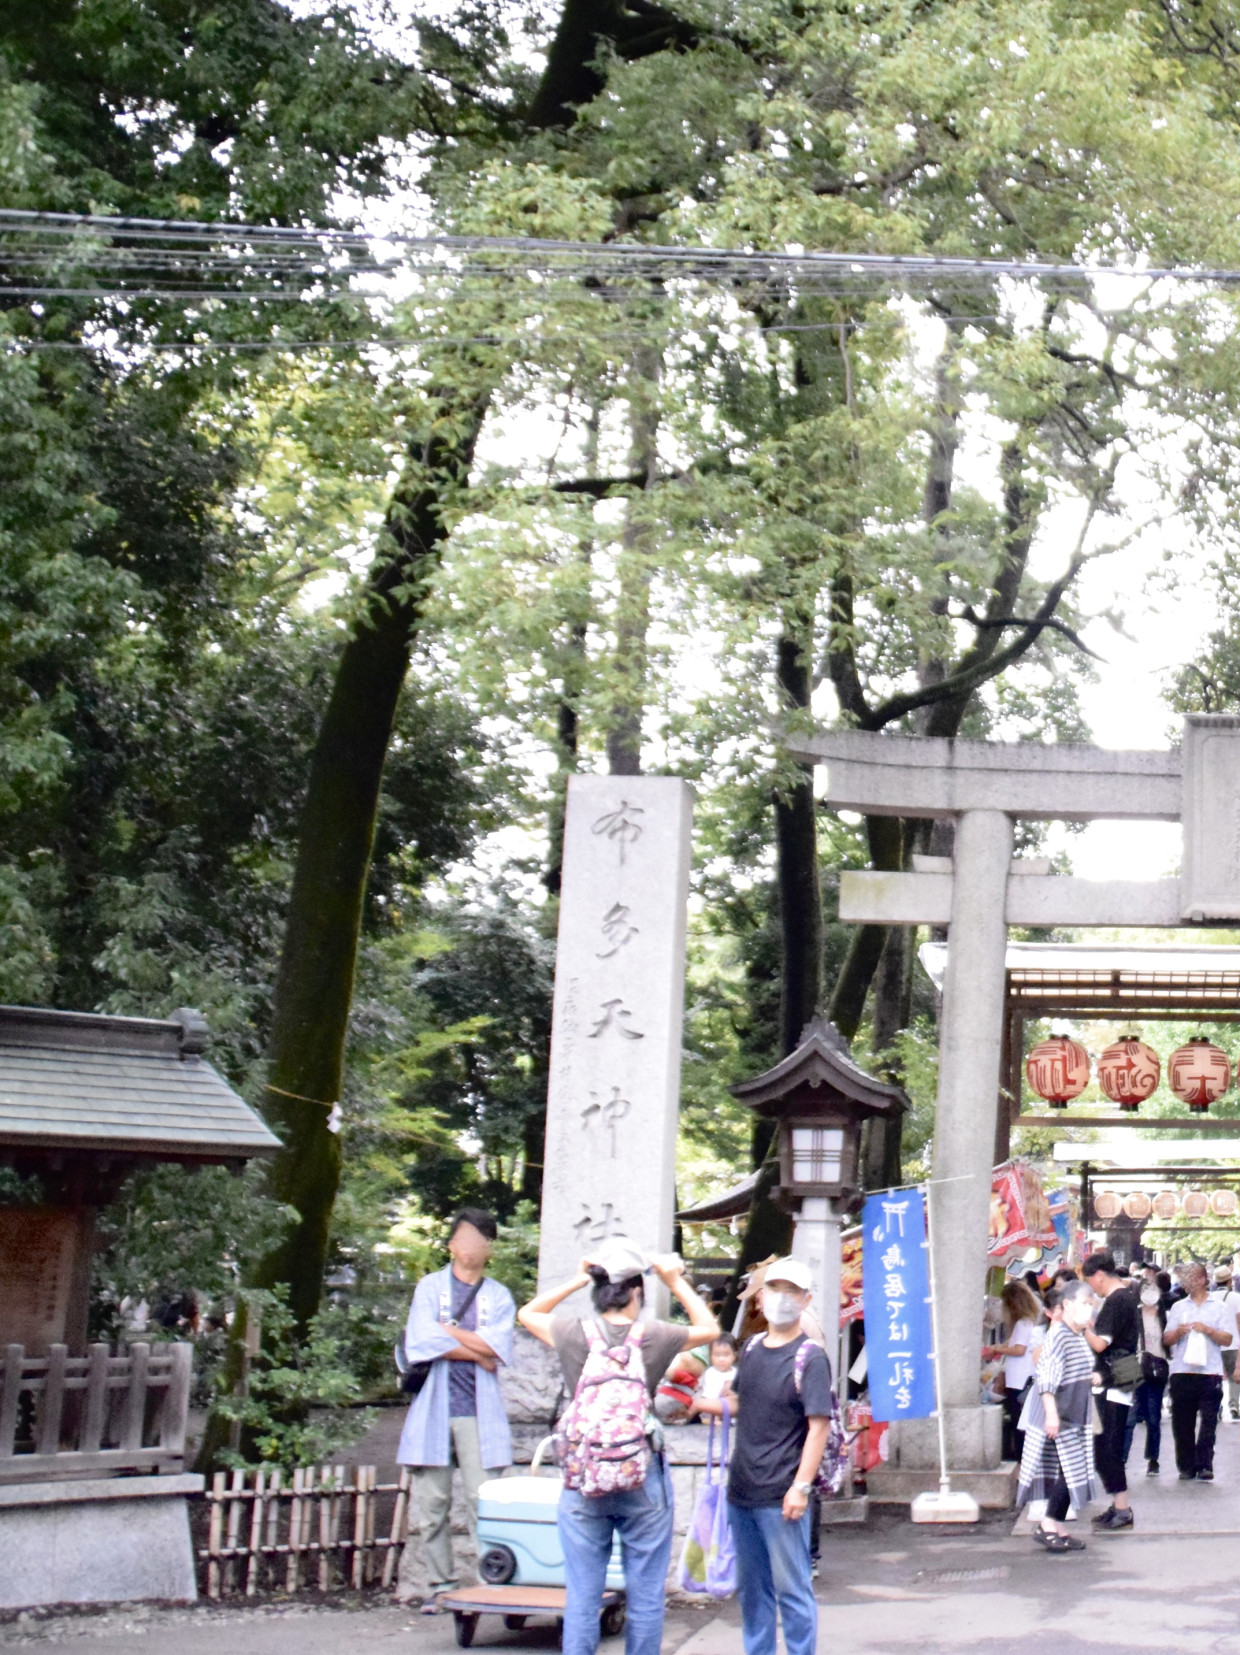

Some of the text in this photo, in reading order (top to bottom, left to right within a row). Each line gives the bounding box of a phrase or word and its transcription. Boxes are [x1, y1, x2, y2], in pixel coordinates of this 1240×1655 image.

[572, 799, 645, 1243] 布多天神社
